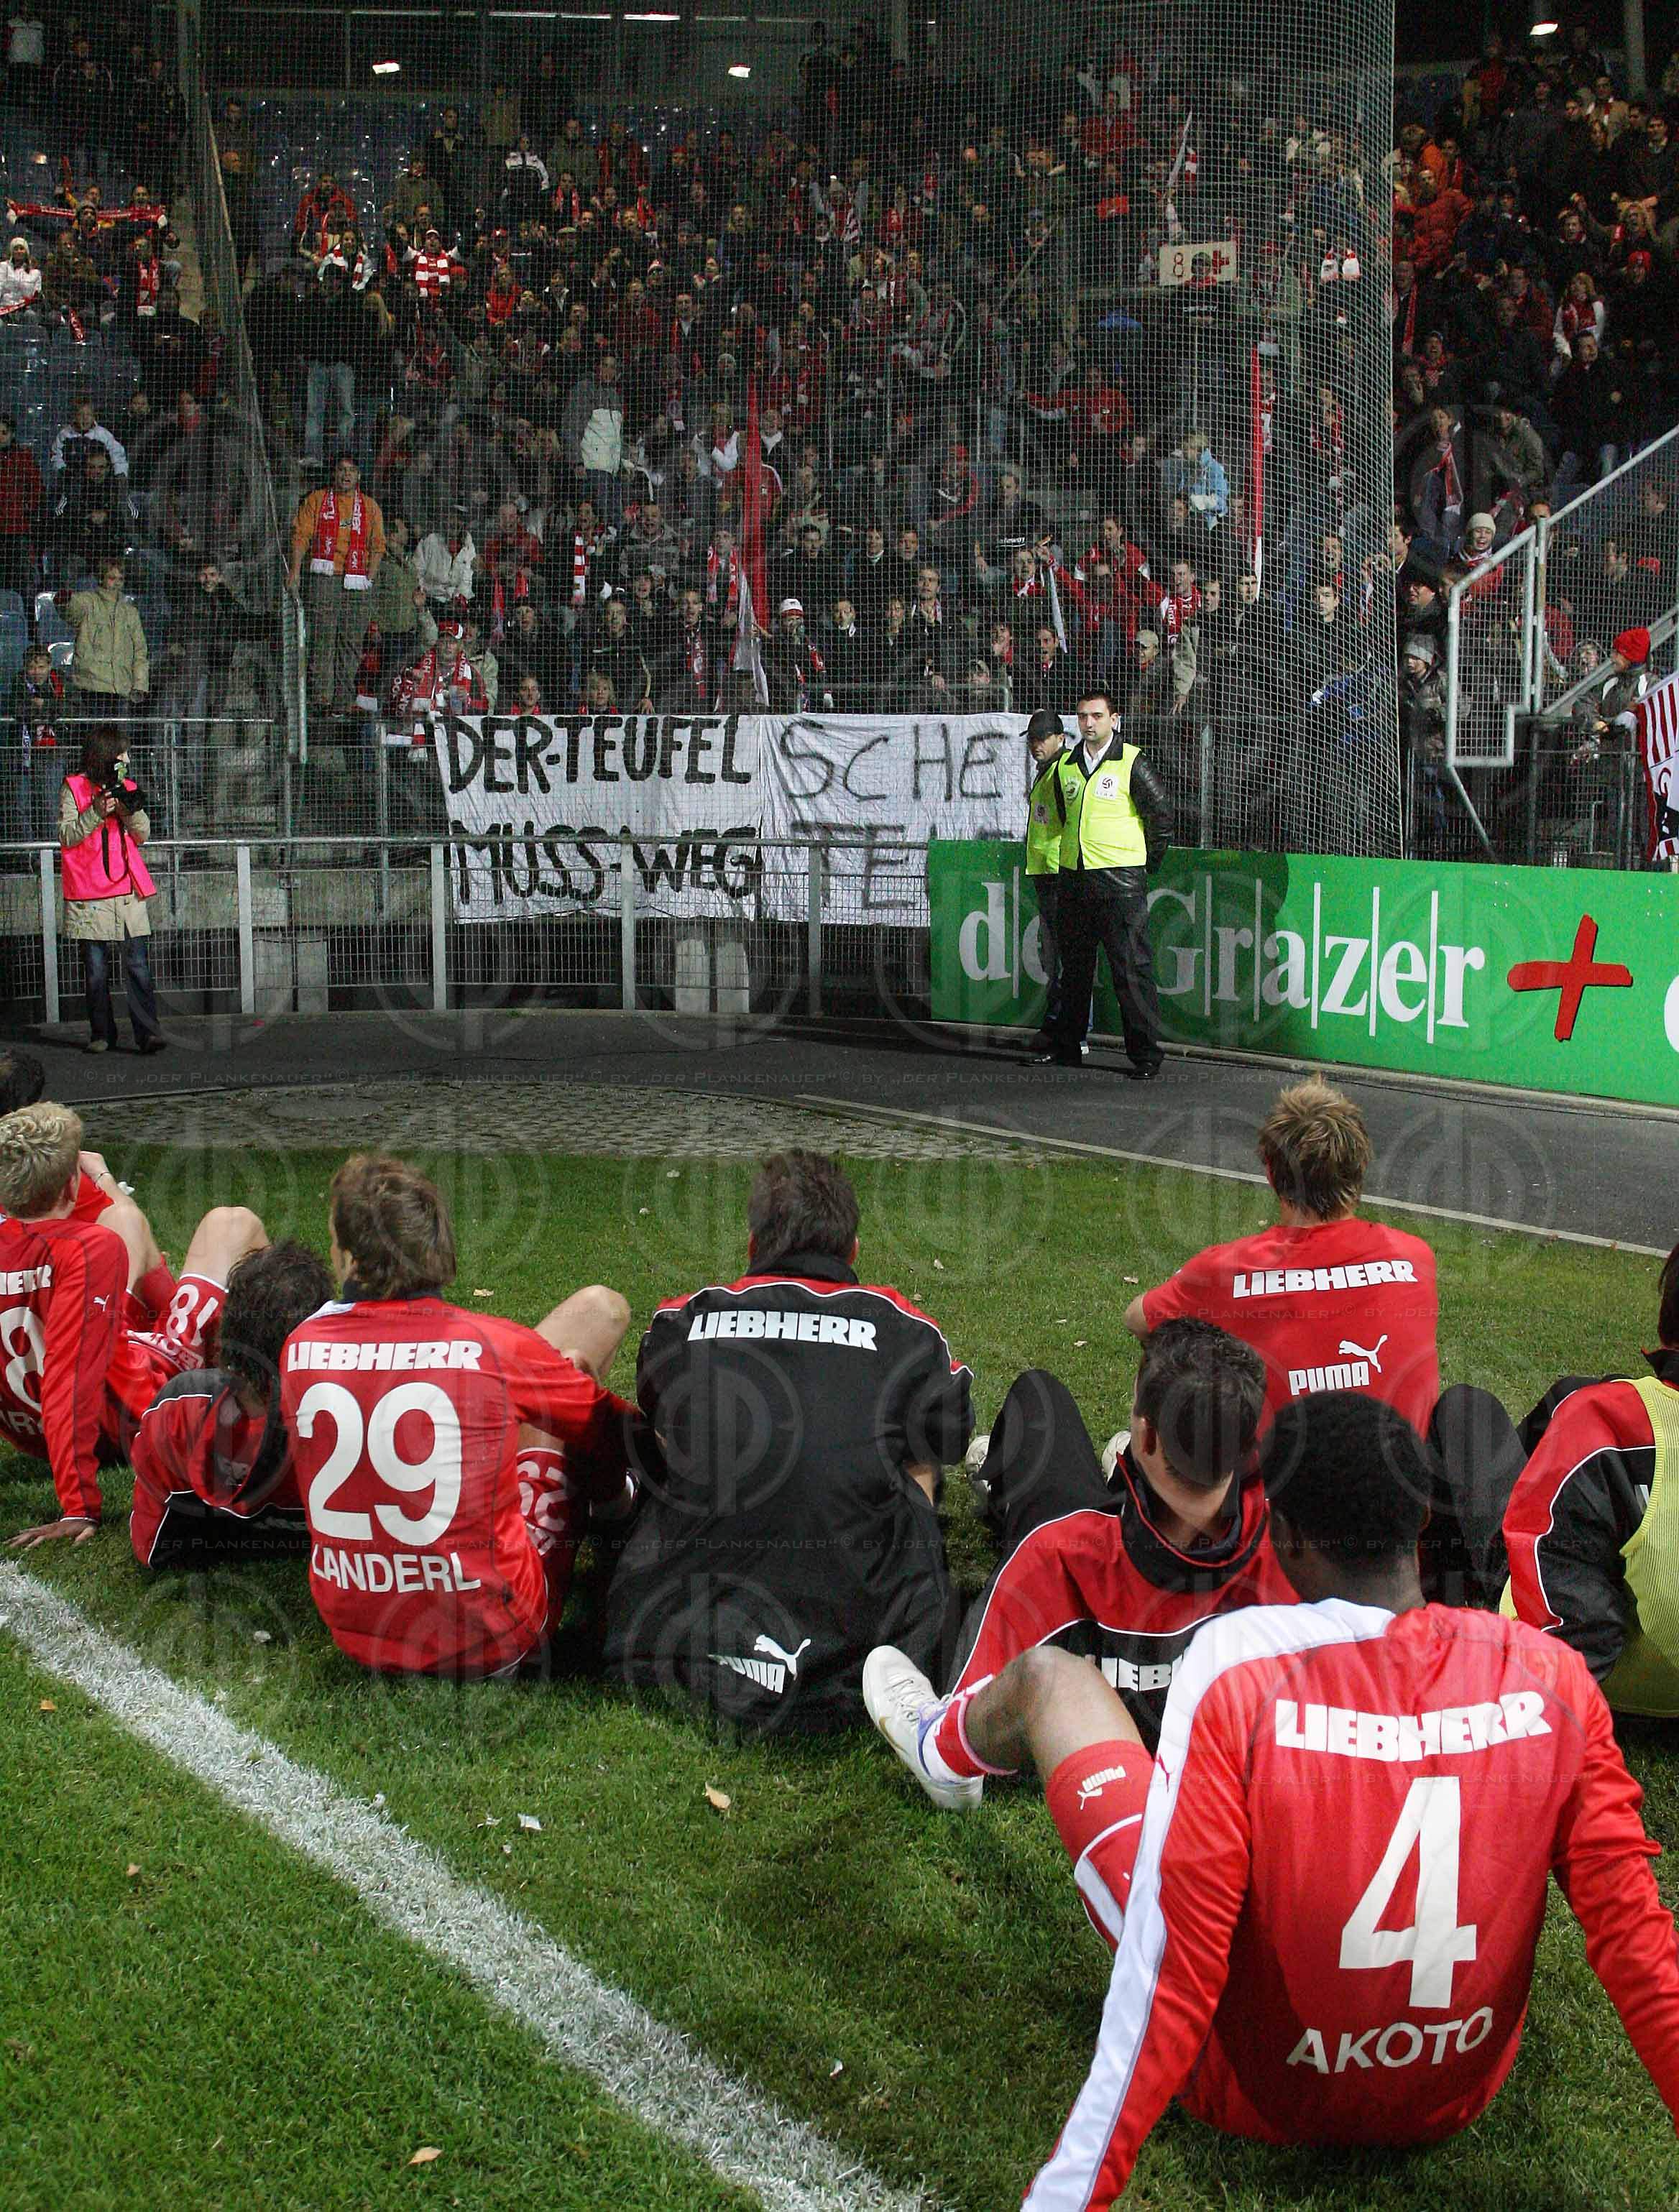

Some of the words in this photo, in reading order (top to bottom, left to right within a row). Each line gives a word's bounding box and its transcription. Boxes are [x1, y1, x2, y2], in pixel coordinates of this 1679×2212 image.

[1233, 1260, 1417, 1298] LIEBHERR
[687, 1310, 878, 1351] LIEBHERR
[288, 1340, 482, 1373] LIEBHERR
[1288, 1361, 1370, 1396] PUMA
[295, 1382, 462, 1546] 29
[312, 1544, 481, 1593] LANDERL
[1276, 1691, 1552, 1762] LIEBHERR
[1339, 1776, 1476, 2009] 4
[1287, 2006, 1494, 2074] AKOTO
